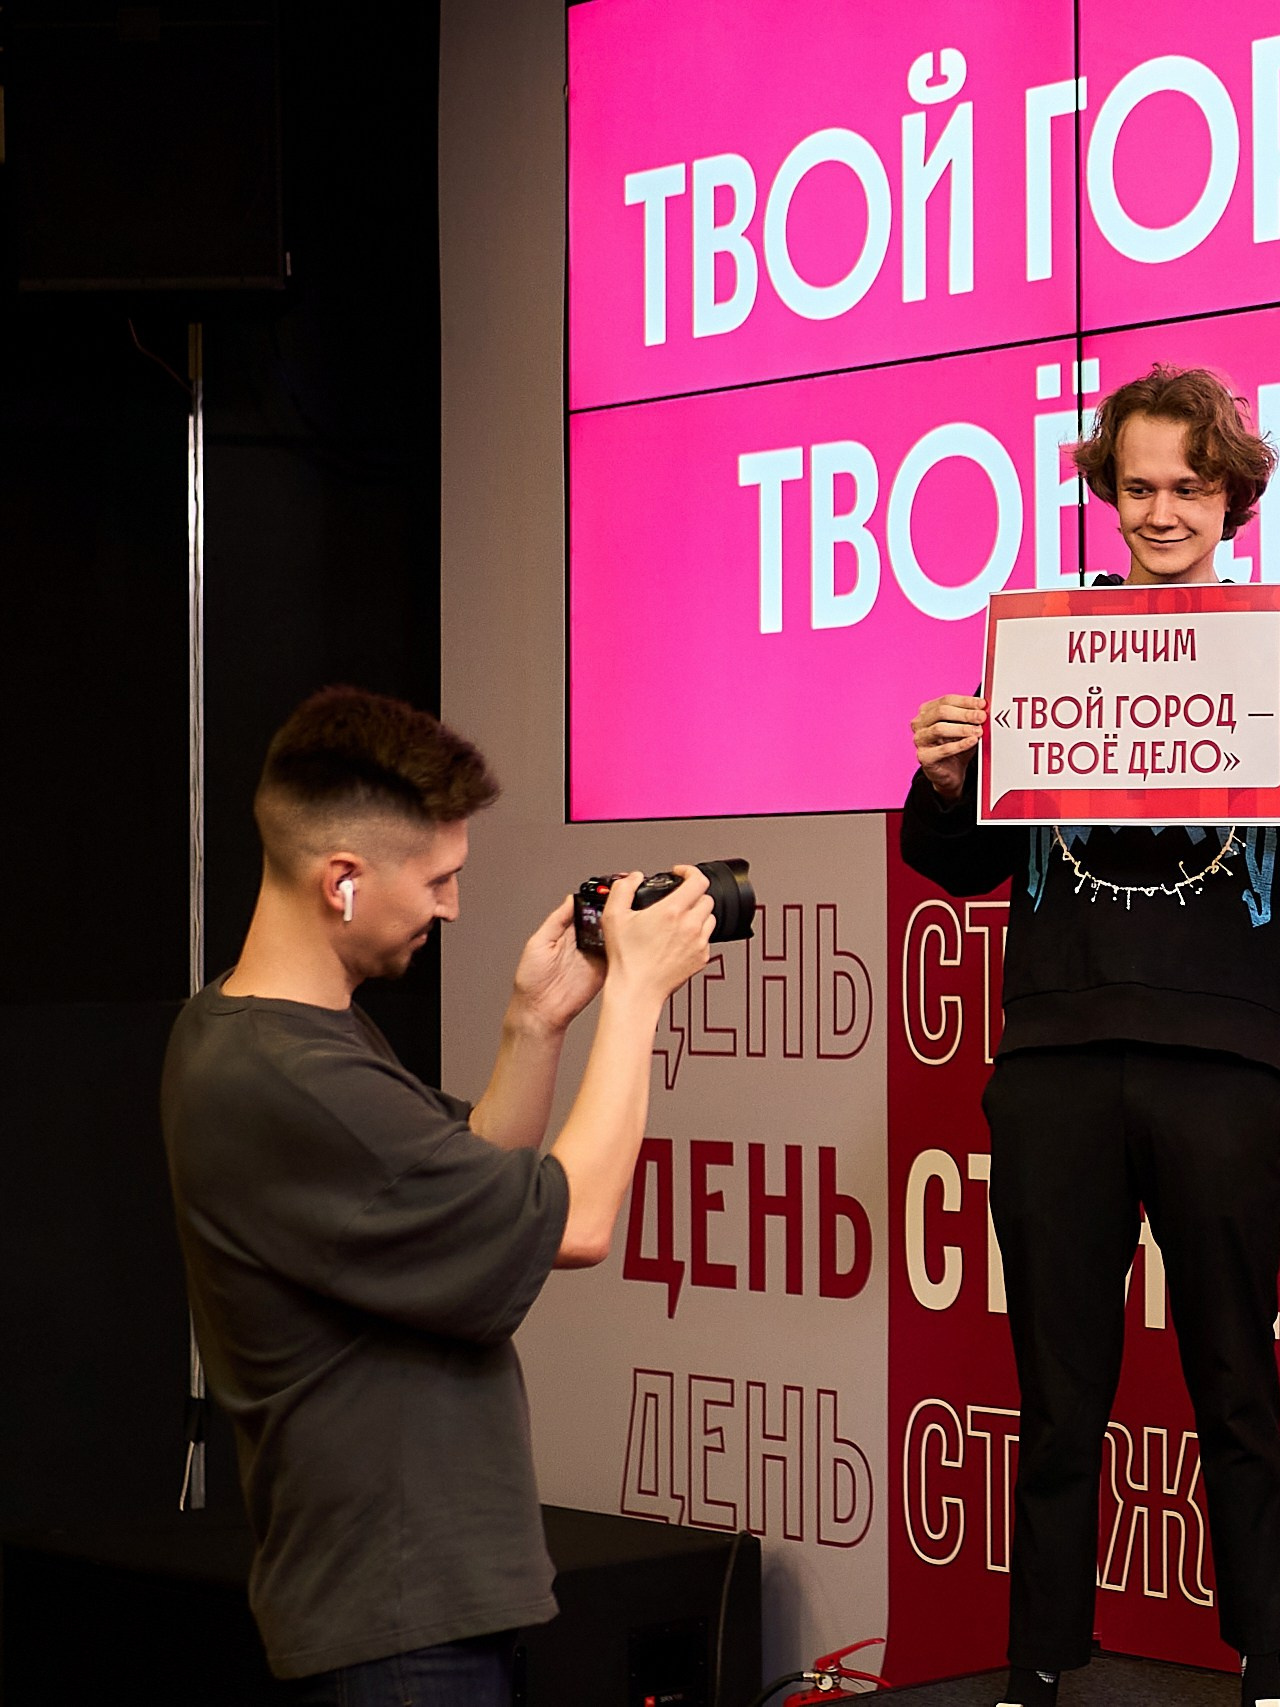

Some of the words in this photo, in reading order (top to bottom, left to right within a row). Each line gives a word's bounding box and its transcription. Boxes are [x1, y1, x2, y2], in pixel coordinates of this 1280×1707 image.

[625, 47, 974, 347] ТВОЙ
[738, 357, 1107, 634] ТВОЁ
[994, 686, 1104, 730] «ТВОЙ
[1115, 693, 1237, 734] ГОРОД
[1067, 628, 1197, 664] КРИЧИМ
[1028, 733, 1118, 775] ТВОЁ
[1128, 739, 1241, 782] ДЕЛО»
[652, 903, 873, 1090] ЕНЬ
[622, 1136, 873, 1319] ДЕНЬ
[620, 1366, 873, 1549] ДЕНЬ
